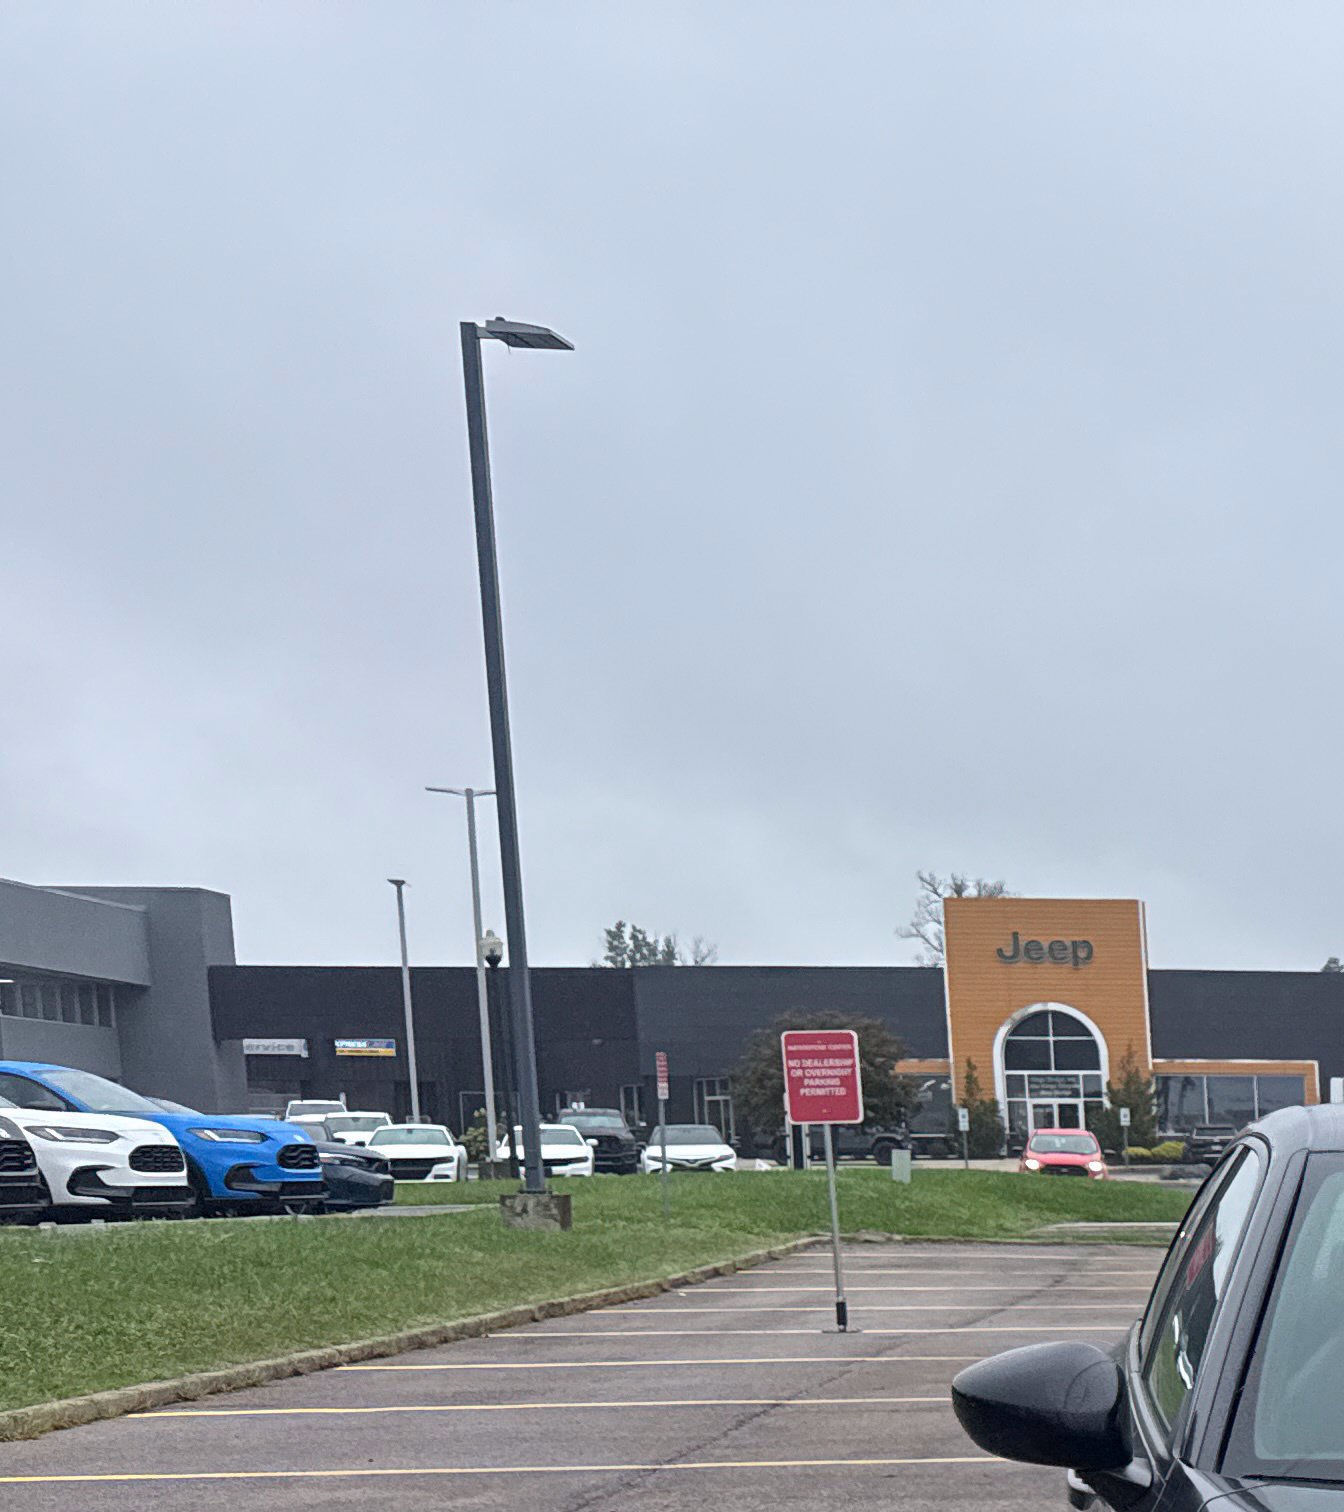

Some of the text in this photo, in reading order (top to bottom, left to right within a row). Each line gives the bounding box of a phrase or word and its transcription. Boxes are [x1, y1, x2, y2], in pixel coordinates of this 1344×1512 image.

[996, 931, 1093, 968] Jeep
[245, 1042, 294, 1051] ervice
[788, 1058, 853, 1067] NO DEALERSHIP
[790, 1068, 852, 1077] OR OVERNIGHT
[804, 1078, 840, 1086] PARKING
[800, 1087, 846, 1096] PERMITTED
